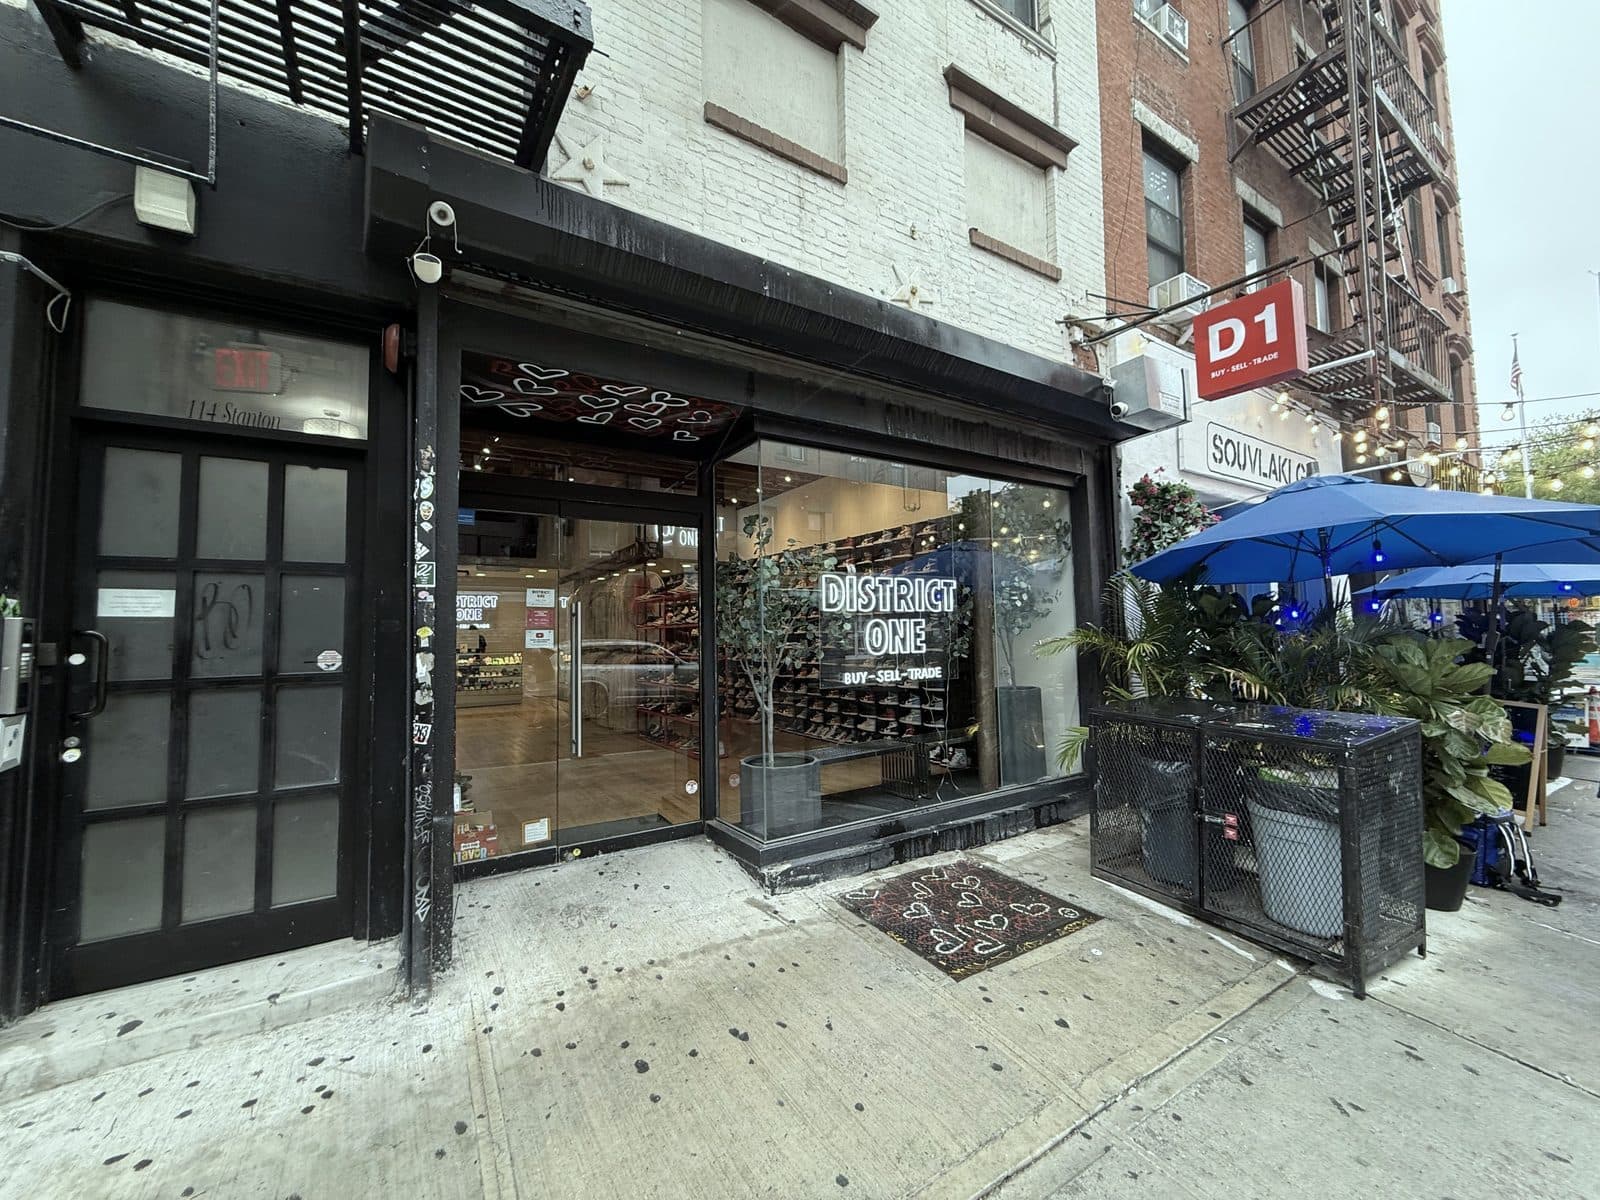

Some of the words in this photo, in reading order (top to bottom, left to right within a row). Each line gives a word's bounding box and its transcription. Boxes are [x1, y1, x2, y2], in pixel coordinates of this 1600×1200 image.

[215, 347, 273, 388] EXIT
[1210, 367, 1226, 379] BUY
[1231, 362, 1249, 373] SELL
[1252, 352, 1279, 366] TRADE
[187, 399, 217, 420] 114
[223, 402, 281, 430] Stanton
[1212, 433, 1291, 485] SOUVLAKI
[679, 530, 698, 546] ON
[821, 574, 957, 613] DISTRICT
[456, 608, 483, 622] ONE
[865, 618, 927, 656] ONE
